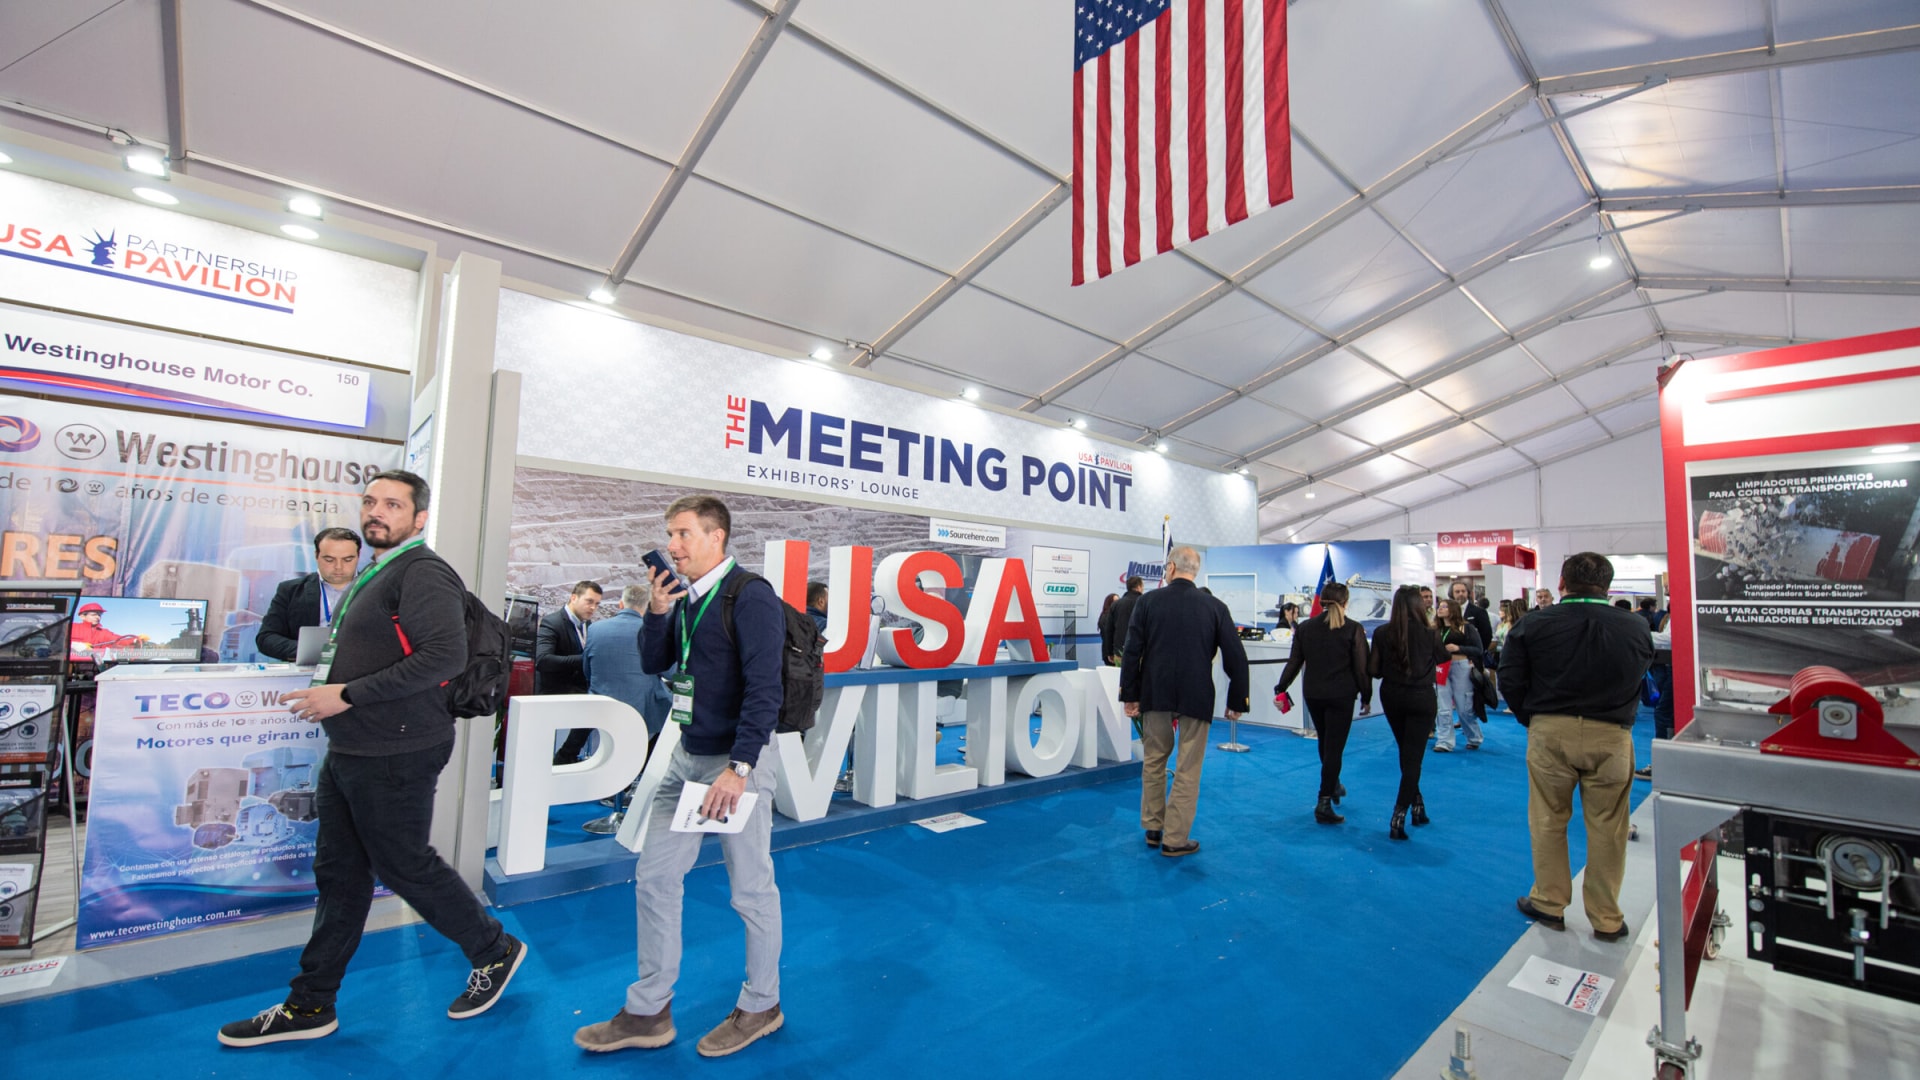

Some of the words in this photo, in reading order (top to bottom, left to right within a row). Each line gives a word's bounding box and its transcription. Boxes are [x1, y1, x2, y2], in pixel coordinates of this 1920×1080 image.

[127, 234, 298, 283] PARTNERSHIP
[124, 249, 297, 304] PAVILION
[4, 333, 196, 380] Westinghouse
[203, 366, 271, 389] Motor
[277, 379, 314, 397] Co.
[337, 373, 360, 386] 150
[725, 395, 746, 449] THE
[748, 399, 1008, 492] MEETING
[1022, 455, 1133, 512] POINT
[1078, 452, 1093, 462] USA
[1100, 457, 1133, 472] PAVILION
[861, 480, 920, 500] LOUNGE
[1709, 490, 1736, 499] PARA
[1737, 486, 1788, 497] CORREAS
[1790, 478, 1908, 494] TRANSPORTADORAS
[1736, 477, 1807, 489] LIMPIADORES
[1810, 472, 1874, 485] PRIMARIOS
[0, 472, 31, 490] de
[115, 483, 173, 502] años
[181, 487, 210, 505] de
[216, 492, 339, 514] experiencia
[949, 529, 1000, 543] Sourcehere.com
[1457, 536, 1477, 544] PLATA
[0, 529, 118, 580] RES
[1046, 585, 1076, 593] FLEXCO
[1743, 590, 1804, 598] Transportadora
[1745, 583, 1784, 591] Limpiador
[764, 540, 1050, 673] USA
[1698, 605, 1729, 614] GUÍAS
[1731, 607, 1758, 615] PARA
[1761, 607, 1813, 616] CORREAS
[1734, 615, 1810, 625] ALINEADORES
[1812, 616, 1903, 626] ESPECILIZADOS
[134, 691, 231, 713] TECO
[156, 720, 181, 731] Con
[184, 718, 209, 730] más
[211, 718, 227, 728] de
[261, 715, 287, 726] años
[136, 735, 214, 750] Motores
[220, 734, 252, 748] que
[257, 729, 300, 745] giran
[305, 728, 319, 739] el
[119, 862, 159, 873] Contamos
[160, 860, 176, 868] con
[188, 854, 218, 864] extenso
[219, 849, 250, 862] catálogo
[251, 848, 260, 856] de
[261, 843, 296, 856] productos
[297, 841, 313, 851] para
[131, 870, 177, 881] Fabricamos
[178, 864, 215, 876] proyectos
[271, 851, 296, 862] medida
[297, 850, 307, 859] de
[89, 907, 242, 941] www.tecowestinghouse.com.mx
